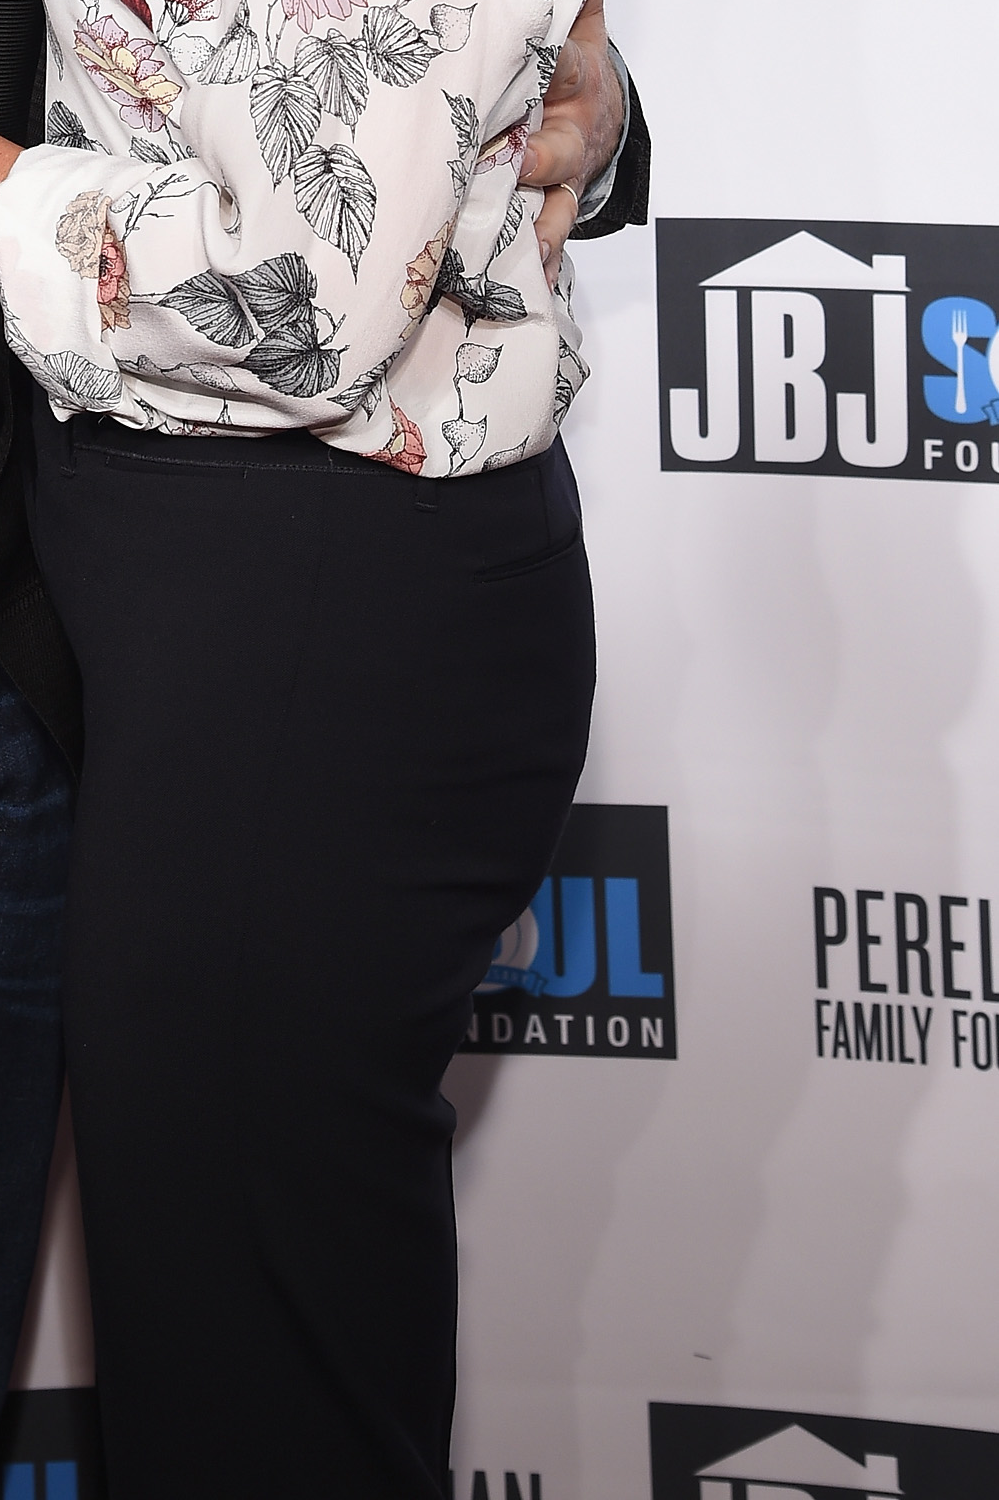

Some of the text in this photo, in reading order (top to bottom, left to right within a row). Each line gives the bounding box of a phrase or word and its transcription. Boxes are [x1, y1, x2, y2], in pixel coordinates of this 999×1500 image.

[670, 290, 999, 468] JBJ S
[492, 876, 664, 998] UL
[813, 886, 999, 1002] PEREL
[812, 999, 999, 1071] FAMILY FO
